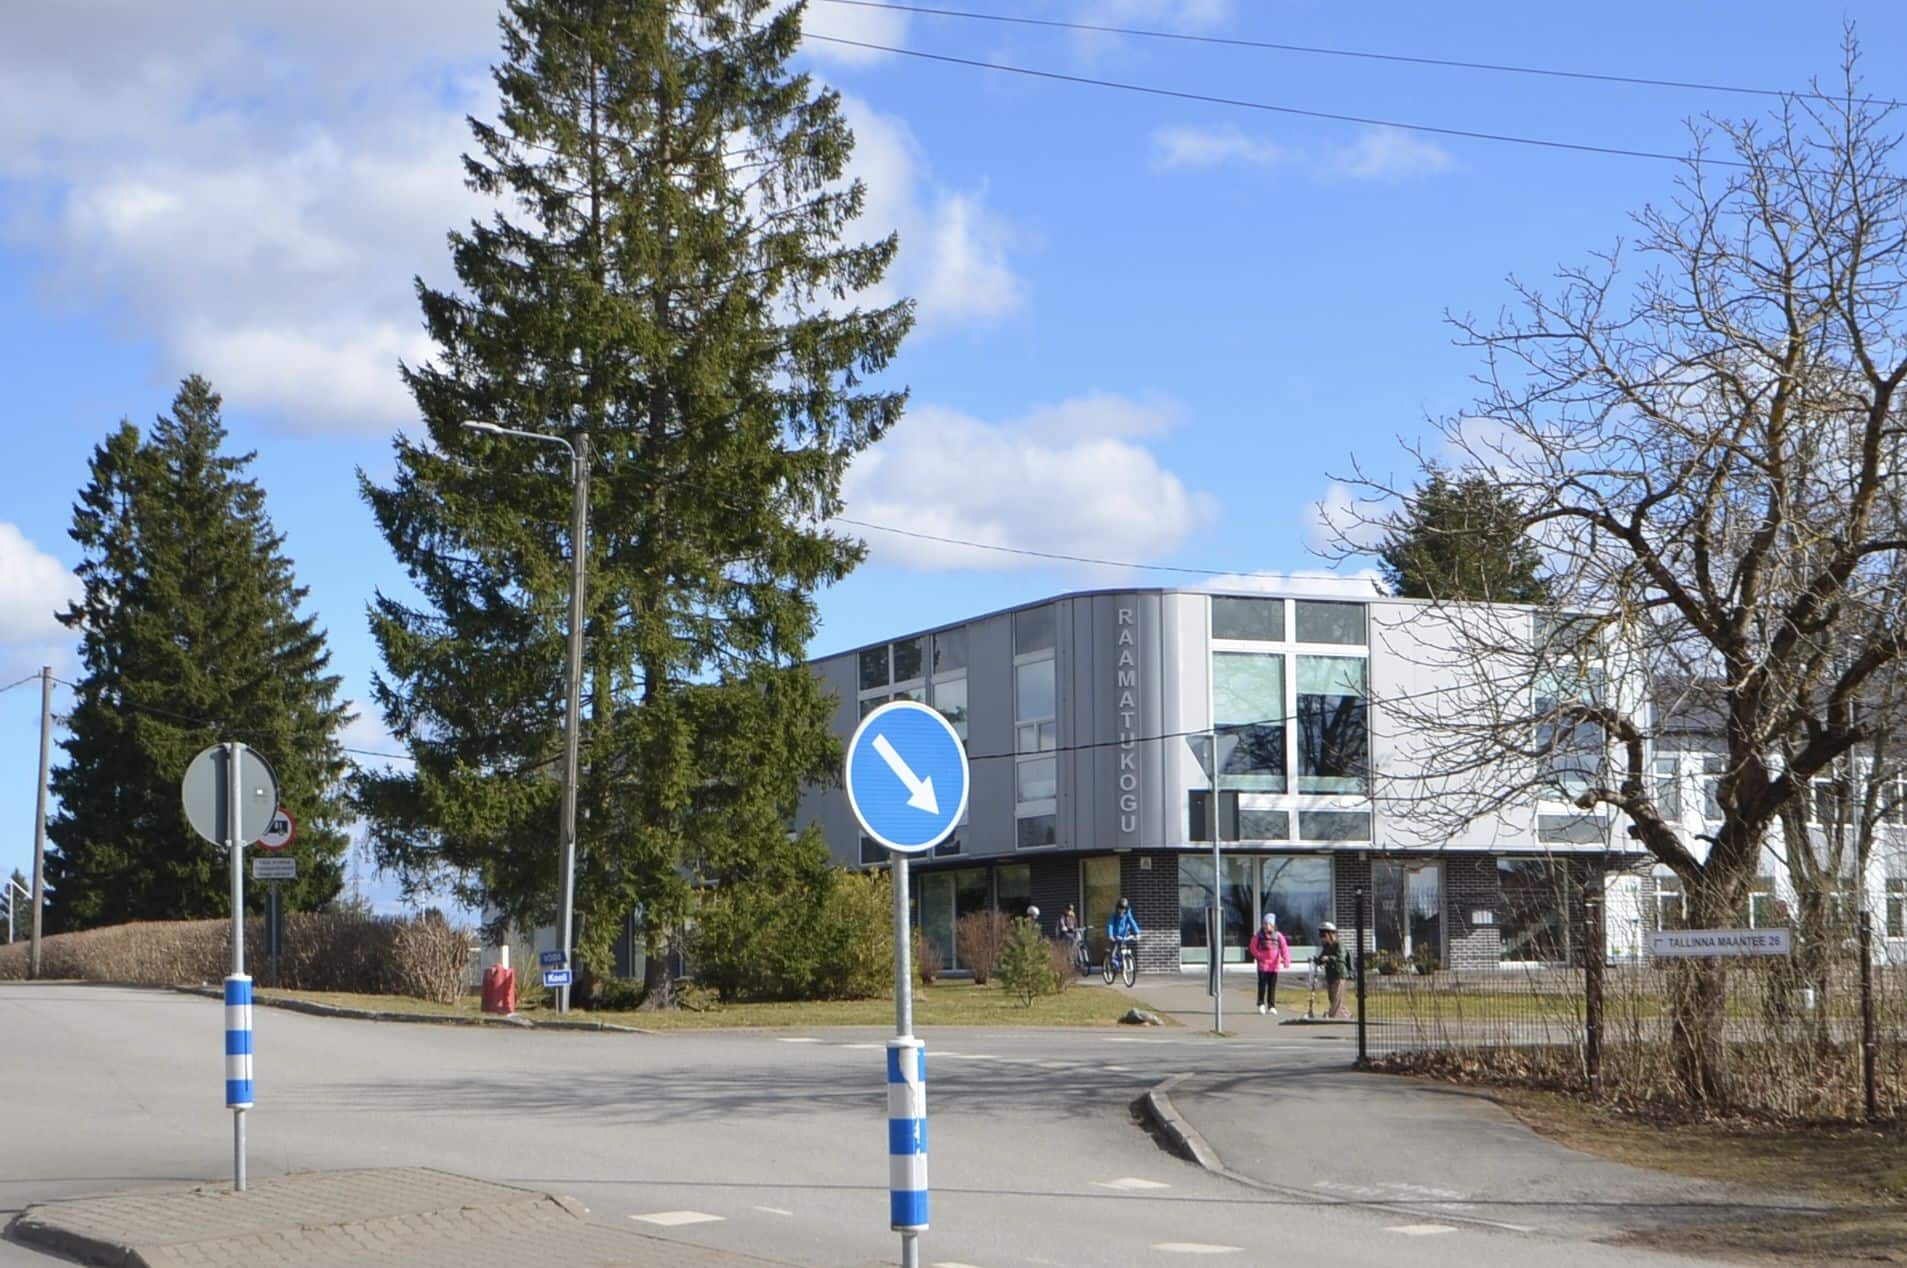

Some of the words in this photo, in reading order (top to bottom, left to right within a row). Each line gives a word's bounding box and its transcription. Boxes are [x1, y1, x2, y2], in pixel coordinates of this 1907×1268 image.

[1118, 608, 1137, 833] RAAMATUKOGU
[1669, 937, 1715, 948] TALLINNA
[1717, 936, 1766, 946] MAANTEE
